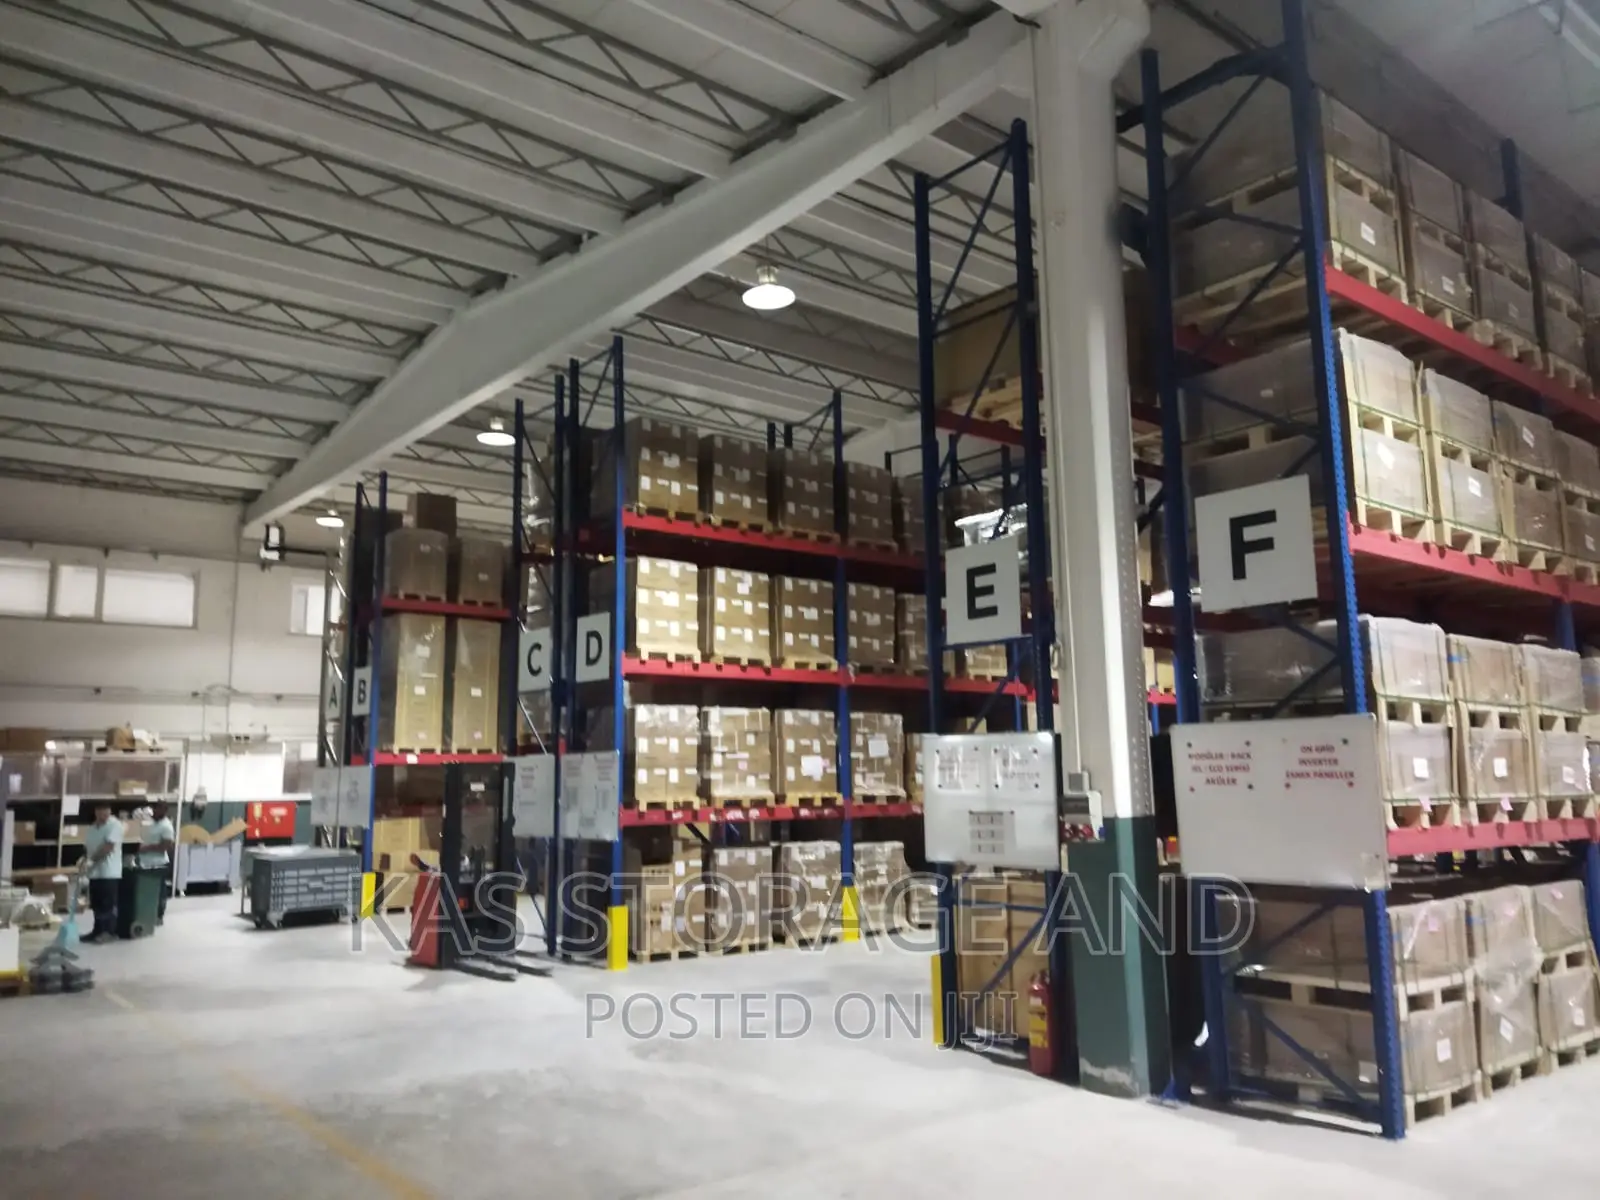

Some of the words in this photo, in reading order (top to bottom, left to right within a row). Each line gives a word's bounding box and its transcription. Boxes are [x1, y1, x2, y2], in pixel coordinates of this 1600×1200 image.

[1229, 510, 1276, 580] F
[966, 563, 998, 620] E
[527, 643, 542, 676] C
[586, 630, 603, 666] D
[329, 687, 338, 708] A
[357, 680, 366, 704] B
